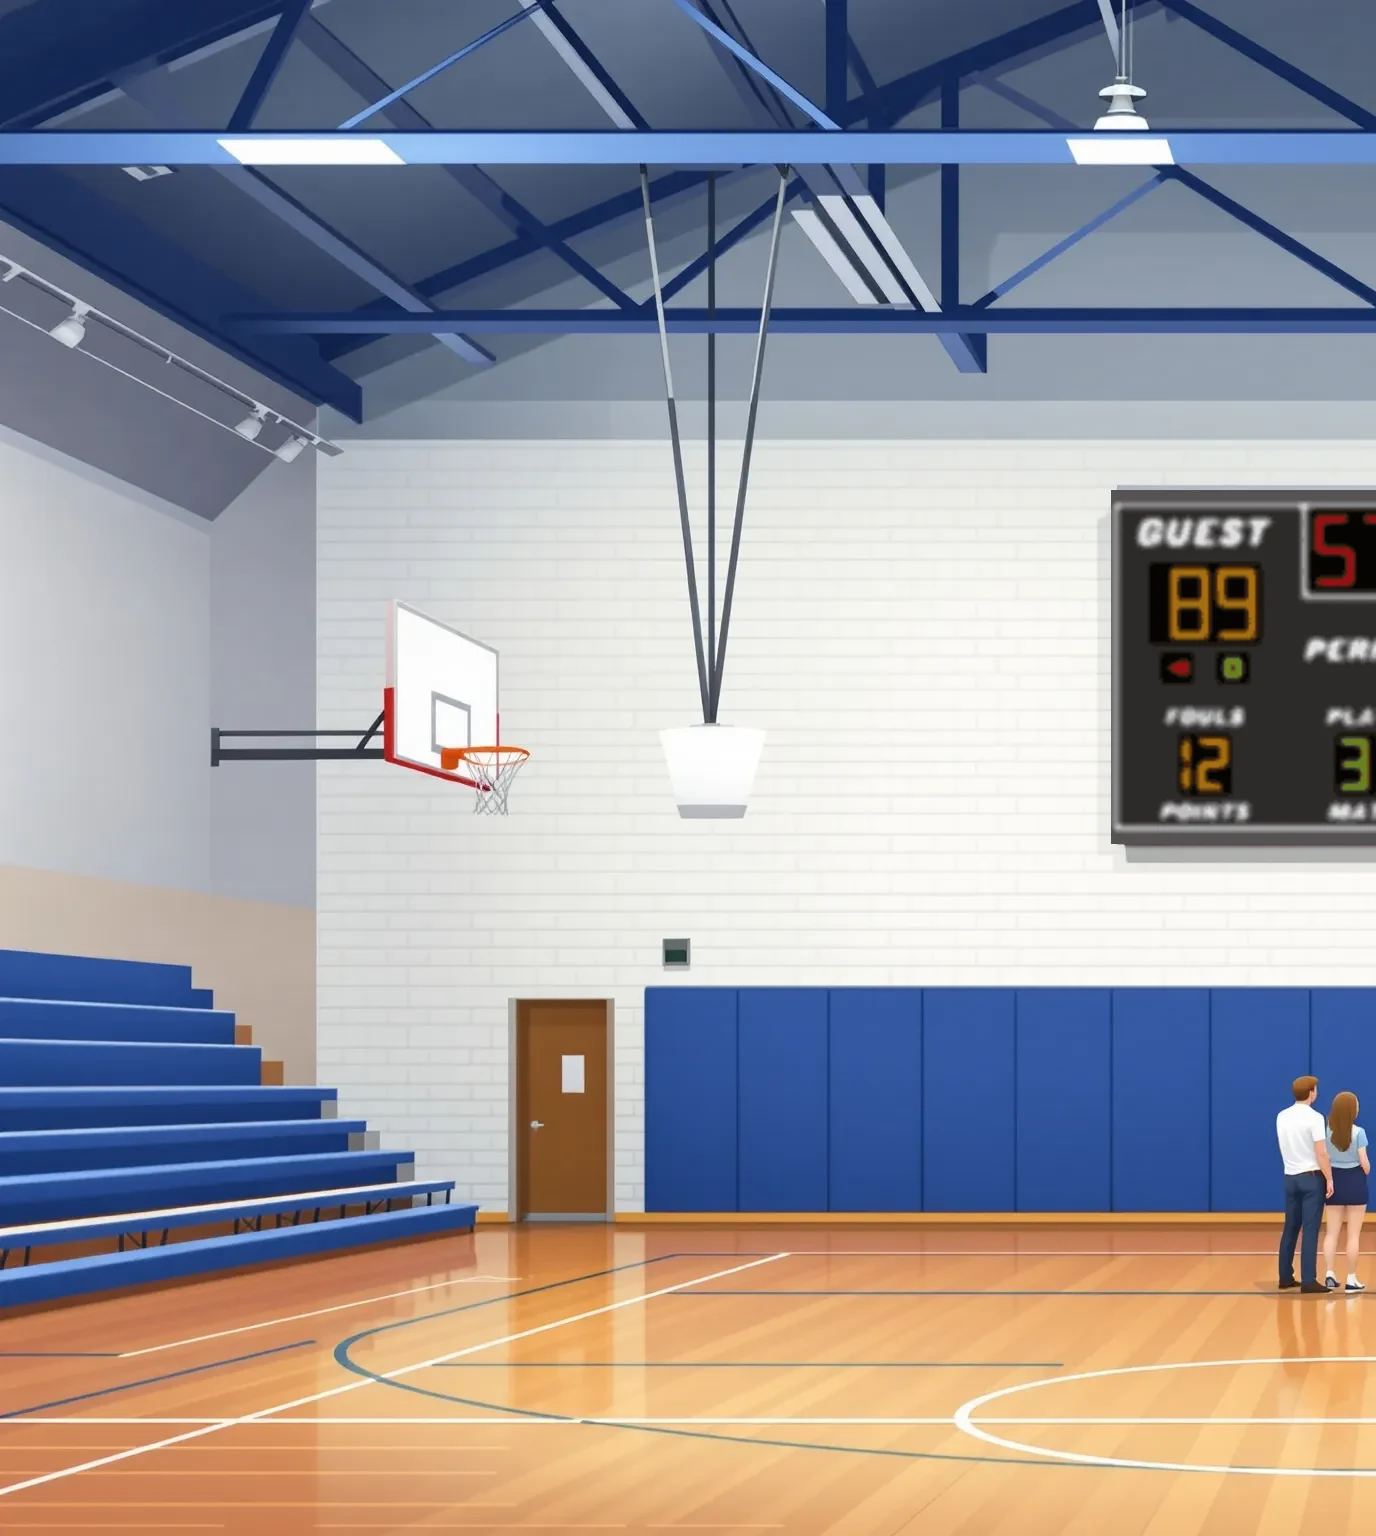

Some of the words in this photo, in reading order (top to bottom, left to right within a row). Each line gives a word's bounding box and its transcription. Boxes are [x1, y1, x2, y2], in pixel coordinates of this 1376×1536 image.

[1136, 516, 1272, 549] GUEST
[1169, 567, 1257, 641] 89
[1180, 737, 1230, 791] 12
